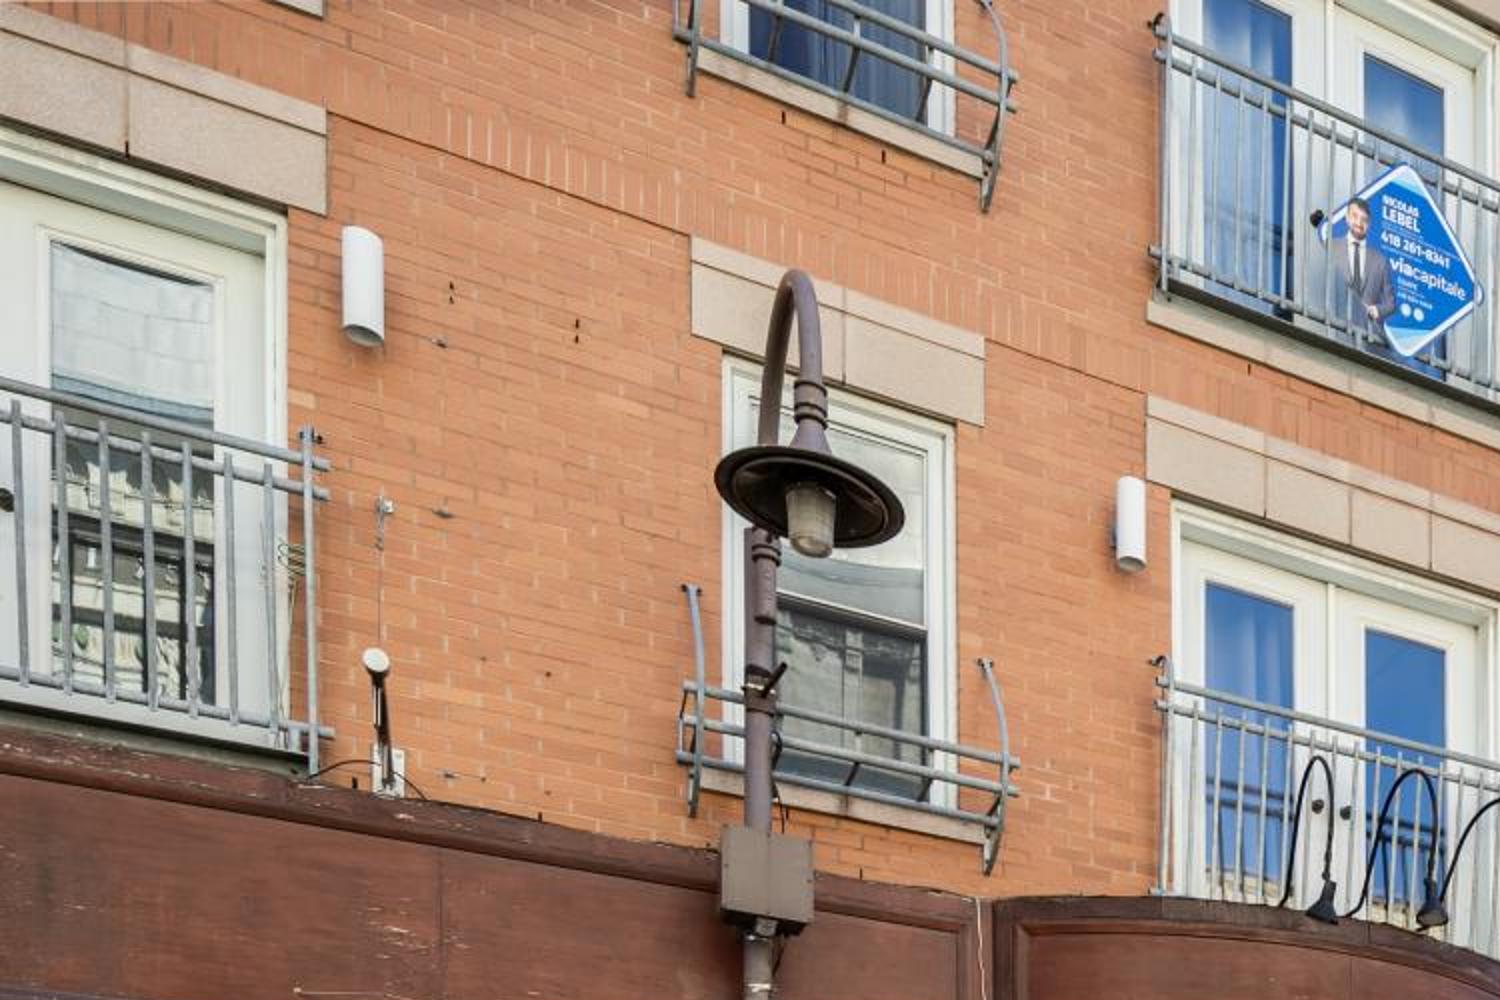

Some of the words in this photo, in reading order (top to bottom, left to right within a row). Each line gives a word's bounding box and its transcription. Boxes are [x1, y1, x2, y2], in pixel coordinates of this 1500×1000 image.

[1382, 206, 1420, 233] LEBEL
[1381, 230, 1400, 248] 418
[1390, 258, 1467, 301] viacapitale
